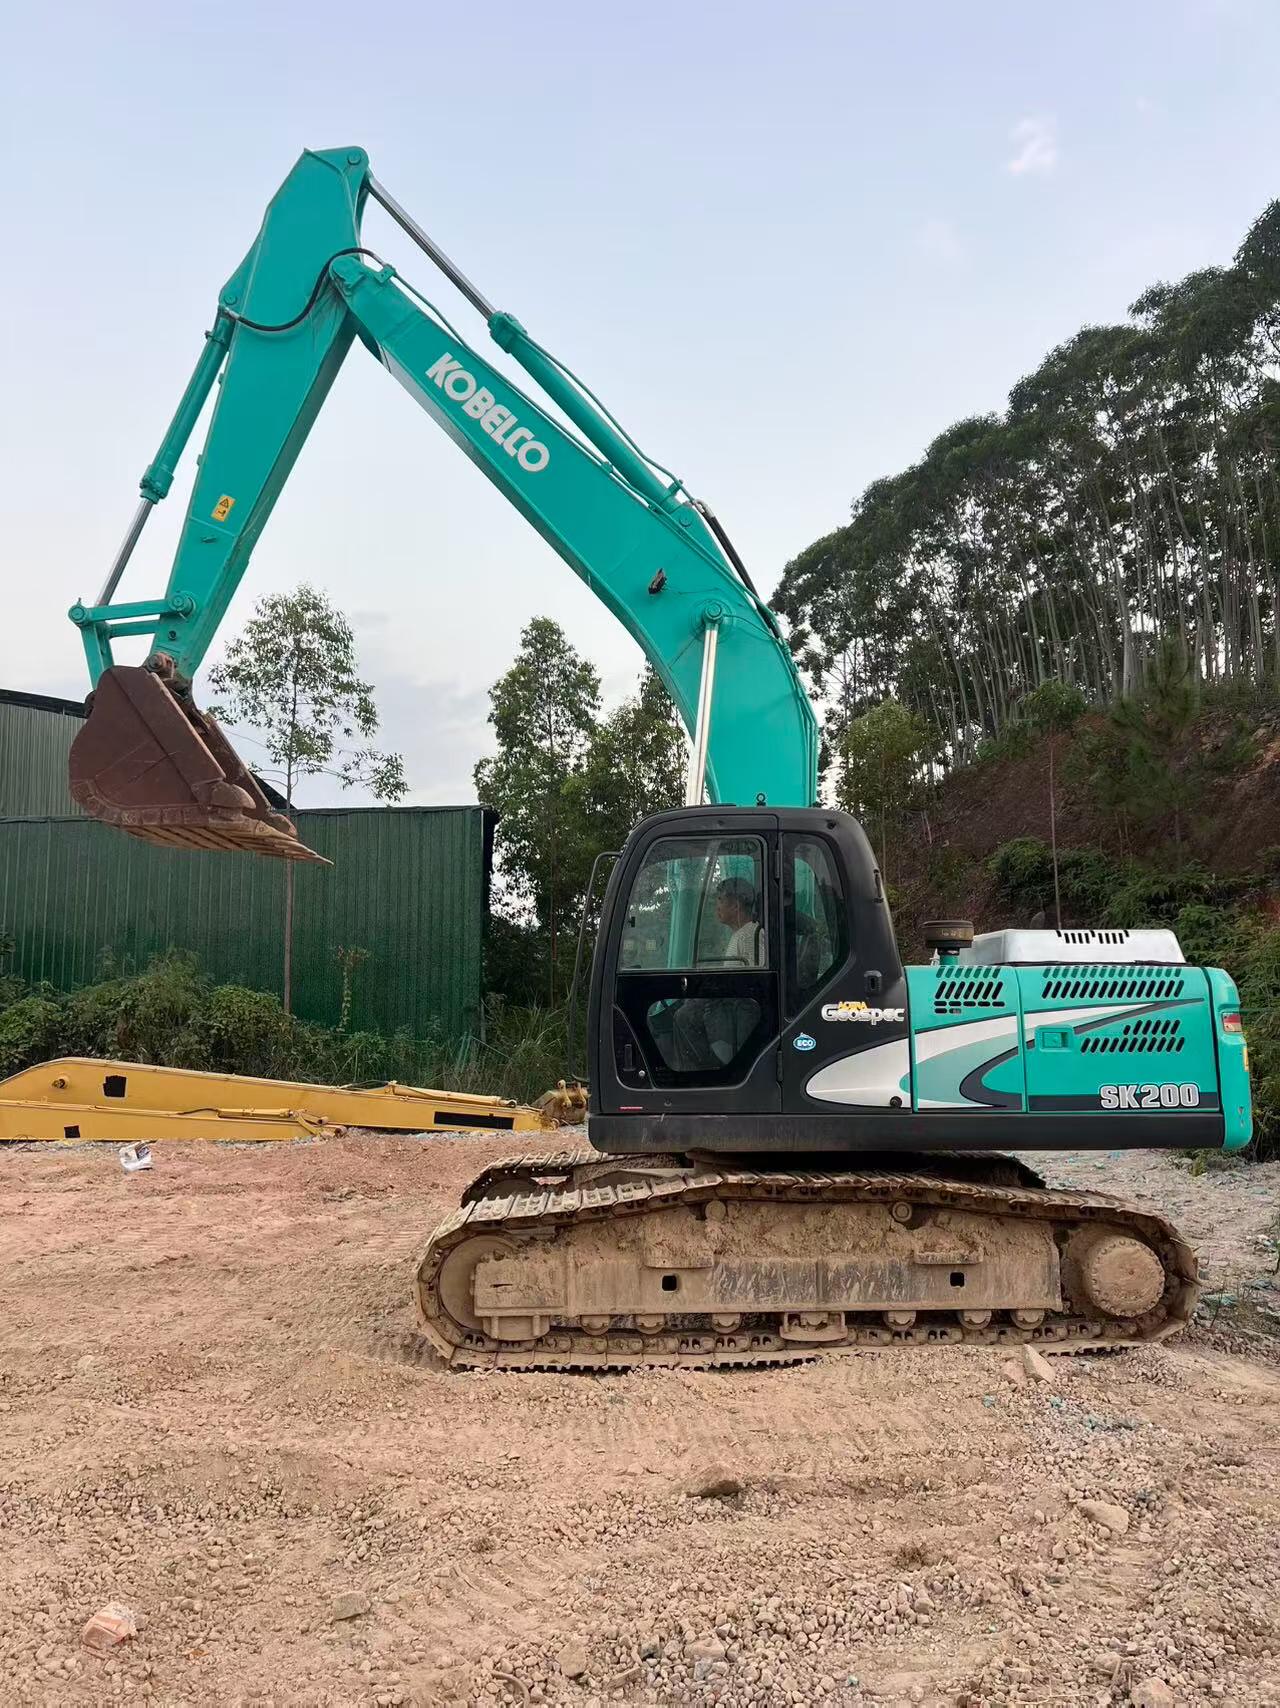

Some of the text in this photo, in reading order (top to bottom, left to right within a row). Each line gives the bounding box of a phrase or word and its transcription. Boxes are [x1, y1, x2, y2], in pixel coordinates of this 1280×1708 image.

[425, 352, 550, 473] KOBELCO
[821, 1003, 905, 1025] Geospec
[797, 1039, 814, 1047] ECO
[1100, 1083, 1200, 1109] SK200
